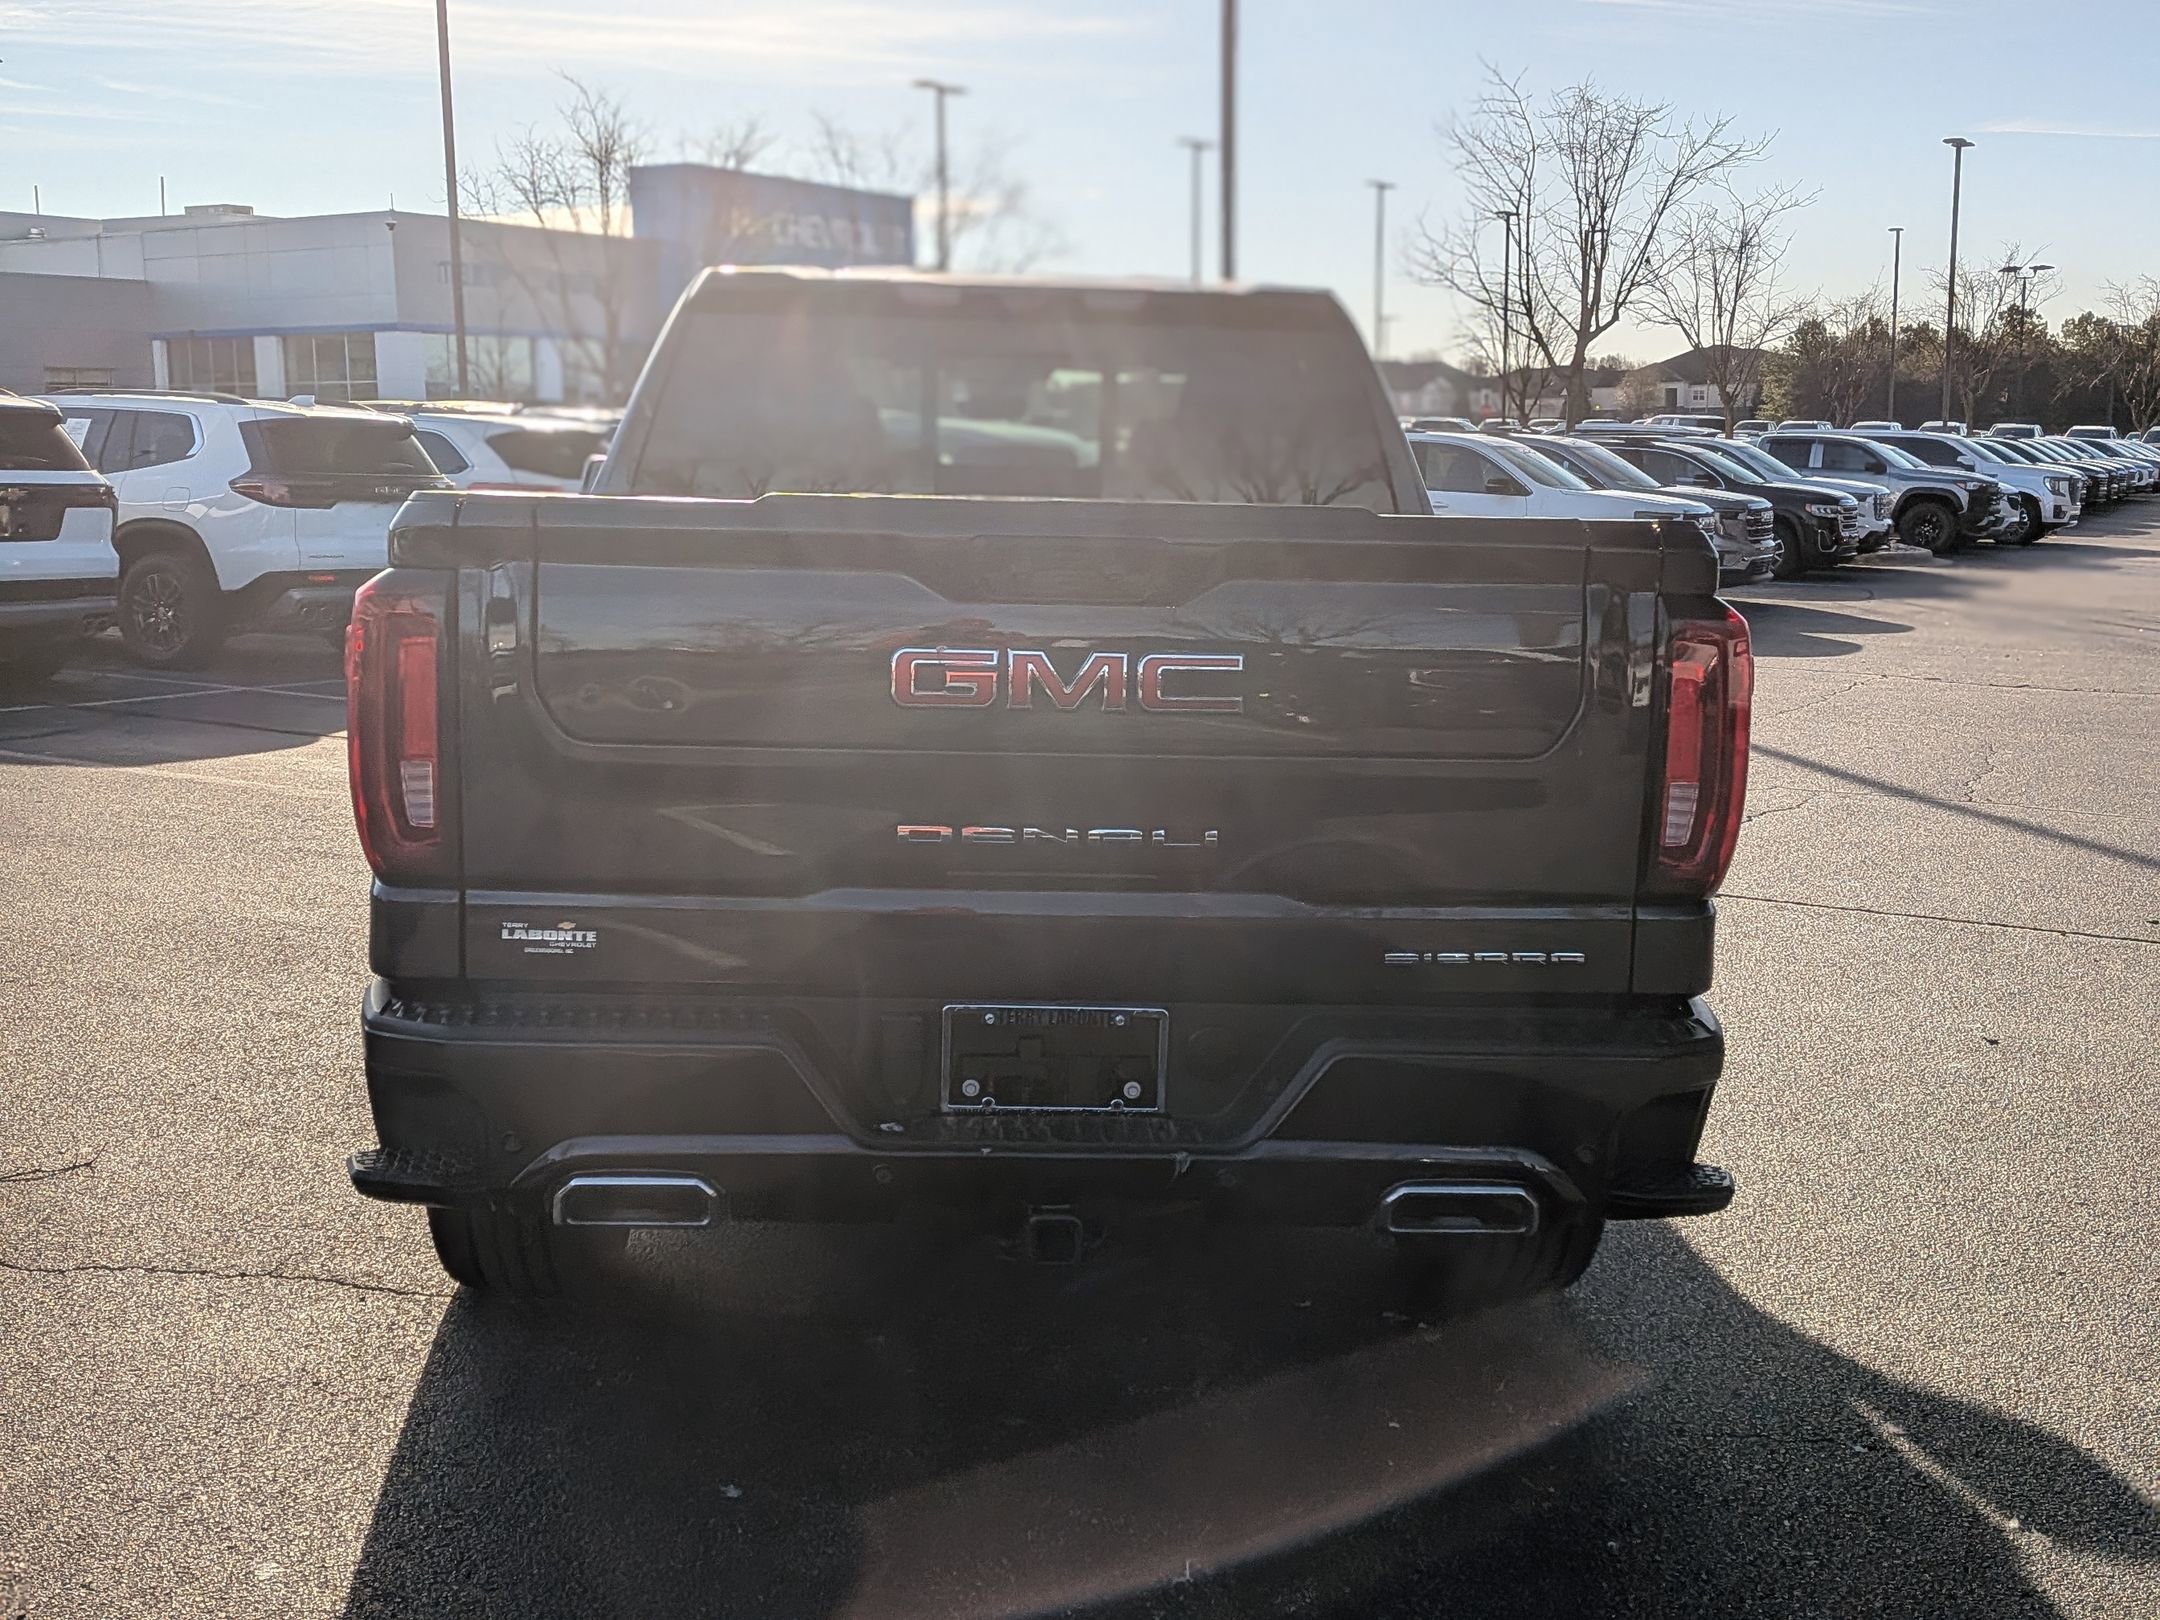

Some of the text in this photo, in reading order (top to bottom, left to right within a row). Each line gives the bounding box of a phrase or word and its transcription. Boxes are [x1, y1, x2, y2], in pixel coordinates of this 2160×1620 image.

[891, 646, 1244, 713] GMC
[897, 825, 1219, 847] DENALI
[501, 929, 597, 941] LABONTE
[1384, 952, 1586, 967] SIERRA
